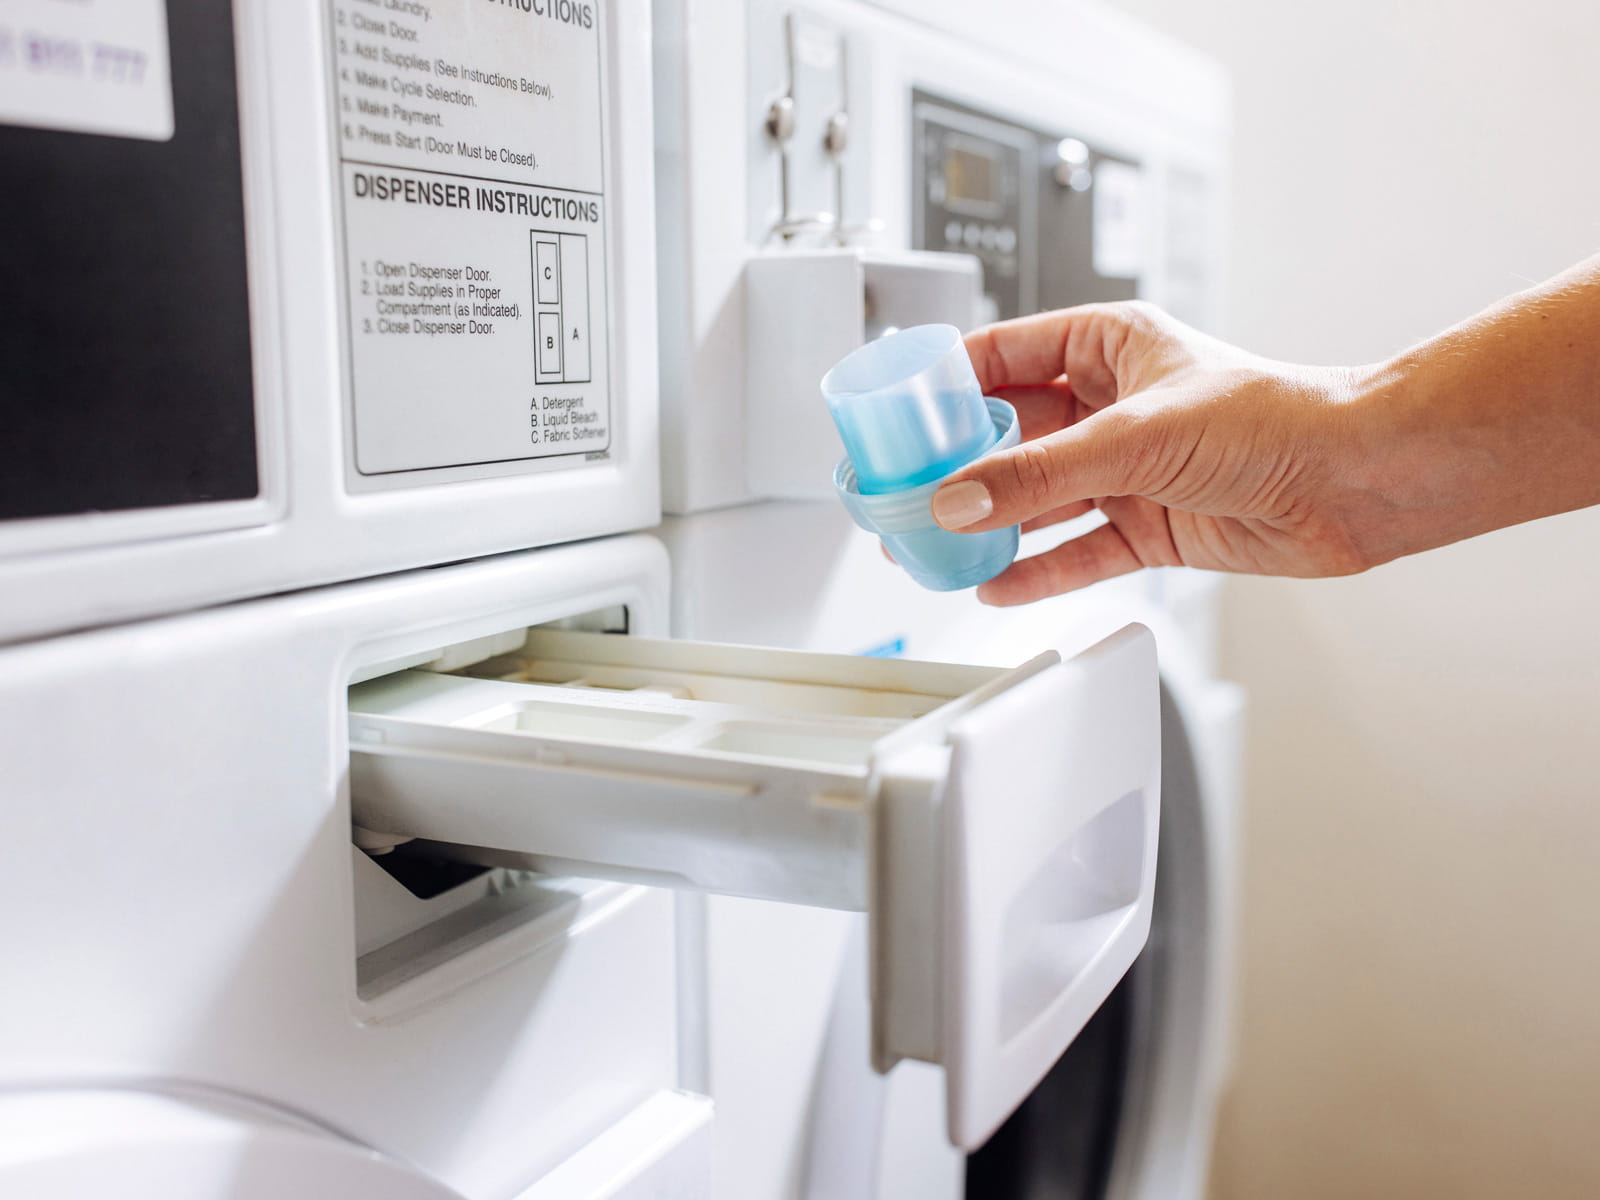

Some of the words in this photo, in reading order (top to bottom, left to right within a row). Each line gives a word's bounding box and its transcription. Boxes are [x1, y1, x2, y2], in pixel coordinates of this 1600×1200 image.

[352, 13, 387, 34] Close
[354, 42, 379, 60] Add
[381, 46, 431, 72] Supplies
[434, 60, 458, 78] (See
[461, 64, 518, 90] Instructions
[520, 79, 554, 98] Below).
[355, 70, 388, 91] Make
[391, 77, 423, 99] Cycle
[426, 84, 477, 108] Selection.
[357, 99, 390, 119] Make
[393, 104, 444, 127] Payment.
[358, 127, 391, 146] Press
[395, 132, 422, 150] Start
[425, 136, 454, 155] (Door
[457, 142, 482, 159] Must
[485, 146, 497, 161] be
[500, 150, 539, 168] Closed).
[354, 173, 470, 209] DISPENSER
[477, 188, 599, 223] INSTRUCTIONS
[375, 261, 406, 279] Open
[409, 262, 463, 281] Dispenser
[466, 266, 492, 281] Door.
[544, 266, 551, 279] C
[361, 281, 371, 295] 2.
[376, 282, 404, 296] Load
[408, 283, 453, 300] Supplies
[456, 285, 465, 298] in
[468, 286, 501, 301] Proper
[376, 300, 450, 319] Compartment
[454, 304, 470, 318] (as
[473, 304, 522, 318] Indicated).
[378, 319, 410, 334] Close
[414, 320, 466, 337] Dispenser
[469, 321, 495, 335] Door.
[572, 328, 579, 340] A
[547, 336, 554, 349] B
[531, 398, 540, 410] A.
[543, 396, 584, 412] Detergent
[531, 414, 540, 427] B.
[543, 413, 568, 429] Liquid
[571, 411, 599, 424] Bleach
[531, 431, 541, 443] C.
[544, 427, 570, 443] Fabric
[573, 426, 606, 440] Softener
